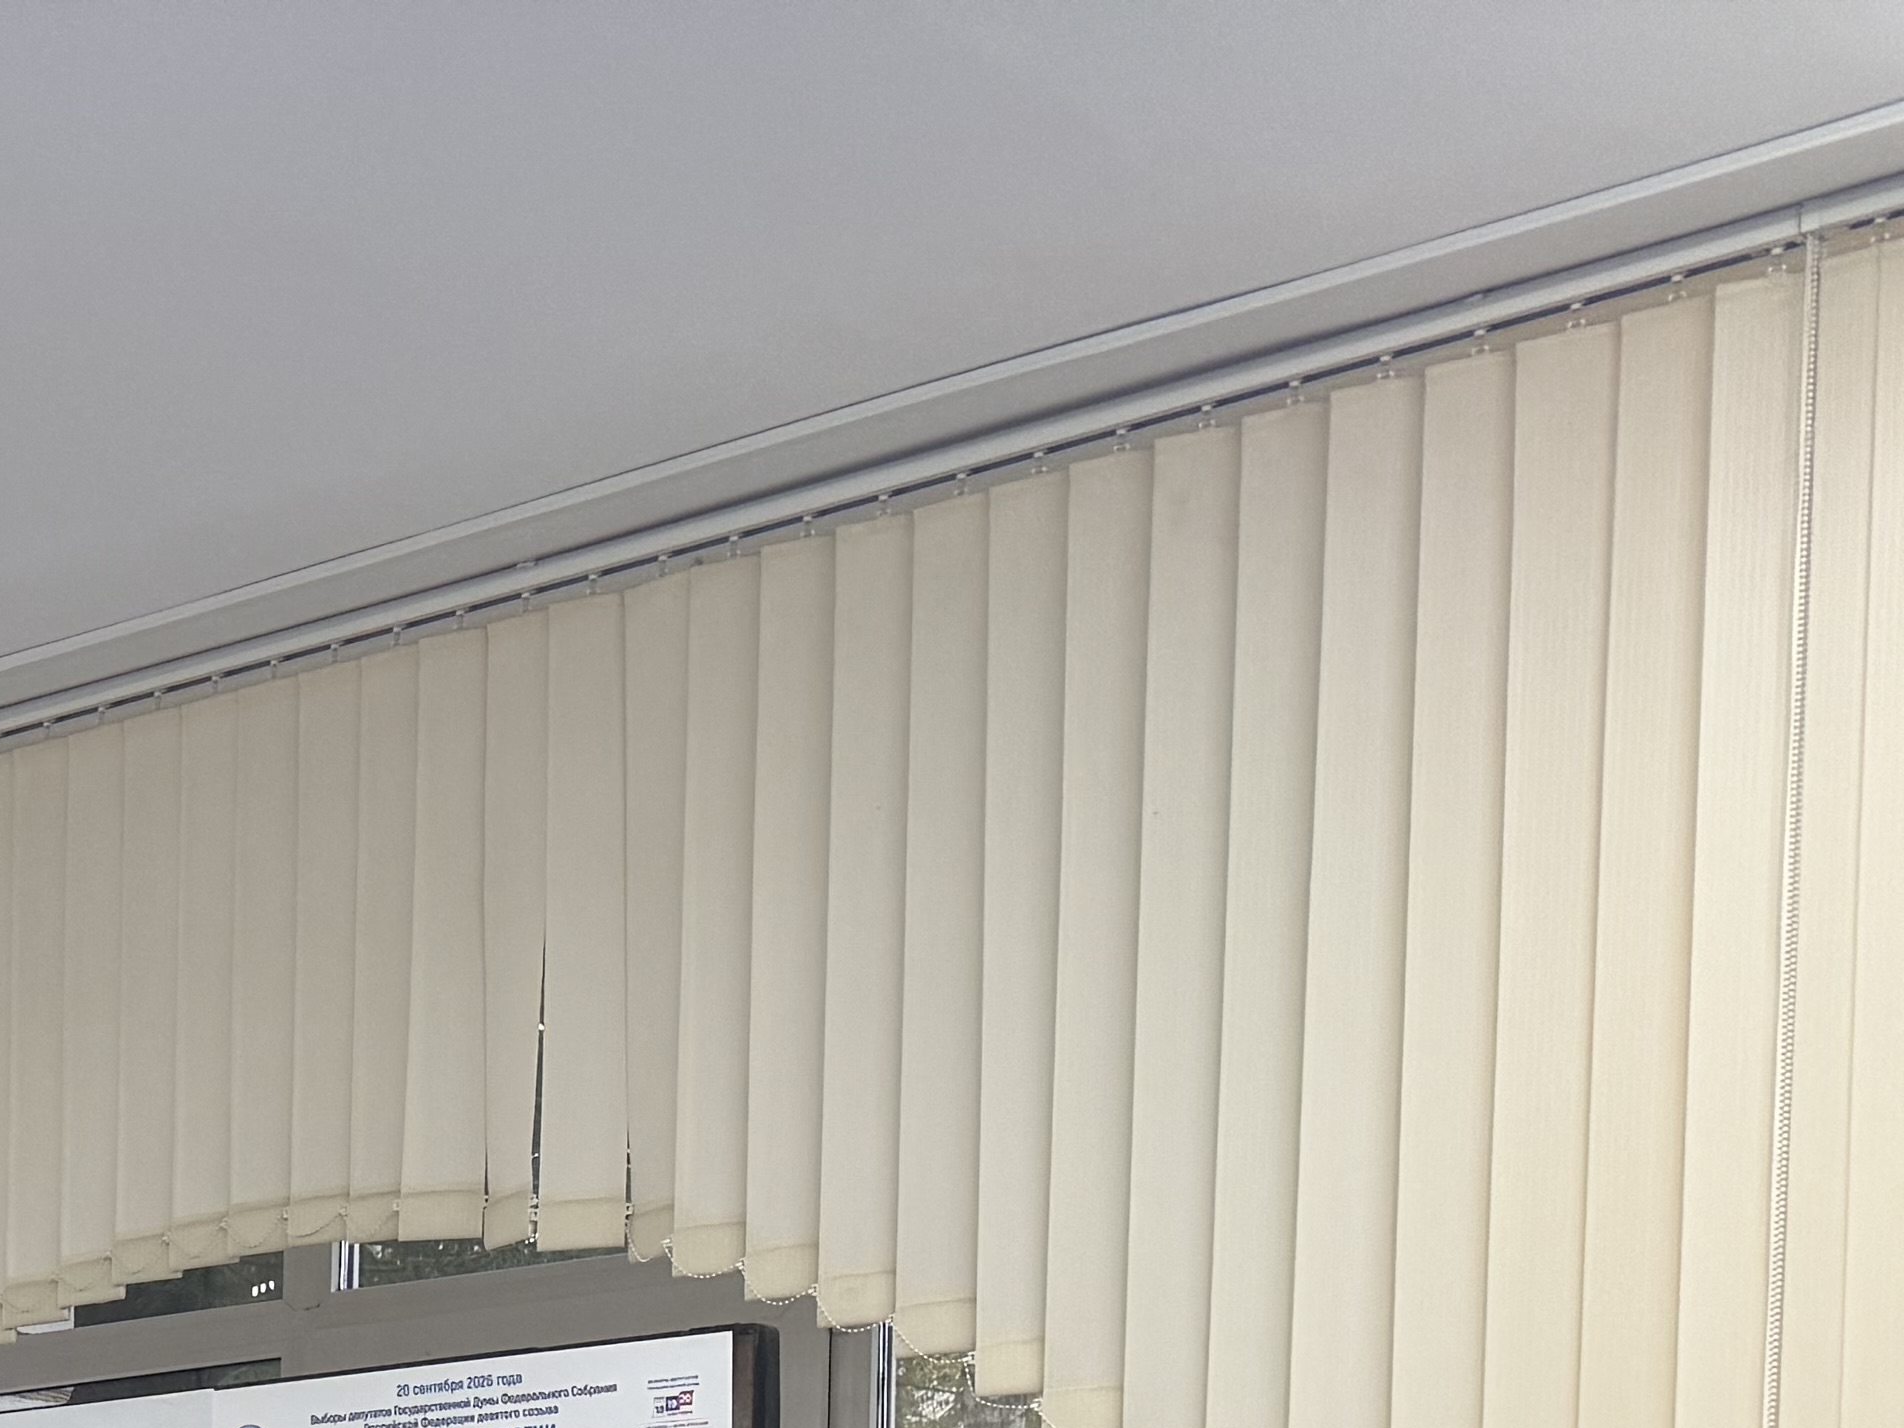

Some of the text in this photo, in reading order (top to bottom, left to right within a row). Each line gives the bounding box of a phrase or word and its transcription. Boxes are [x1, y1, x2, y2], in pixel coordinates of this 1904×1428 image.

[397, 1384, 410, 1397] 20
[413, 1379, 464, 1396] сентября
[496, 1373, 523, 1386] года
